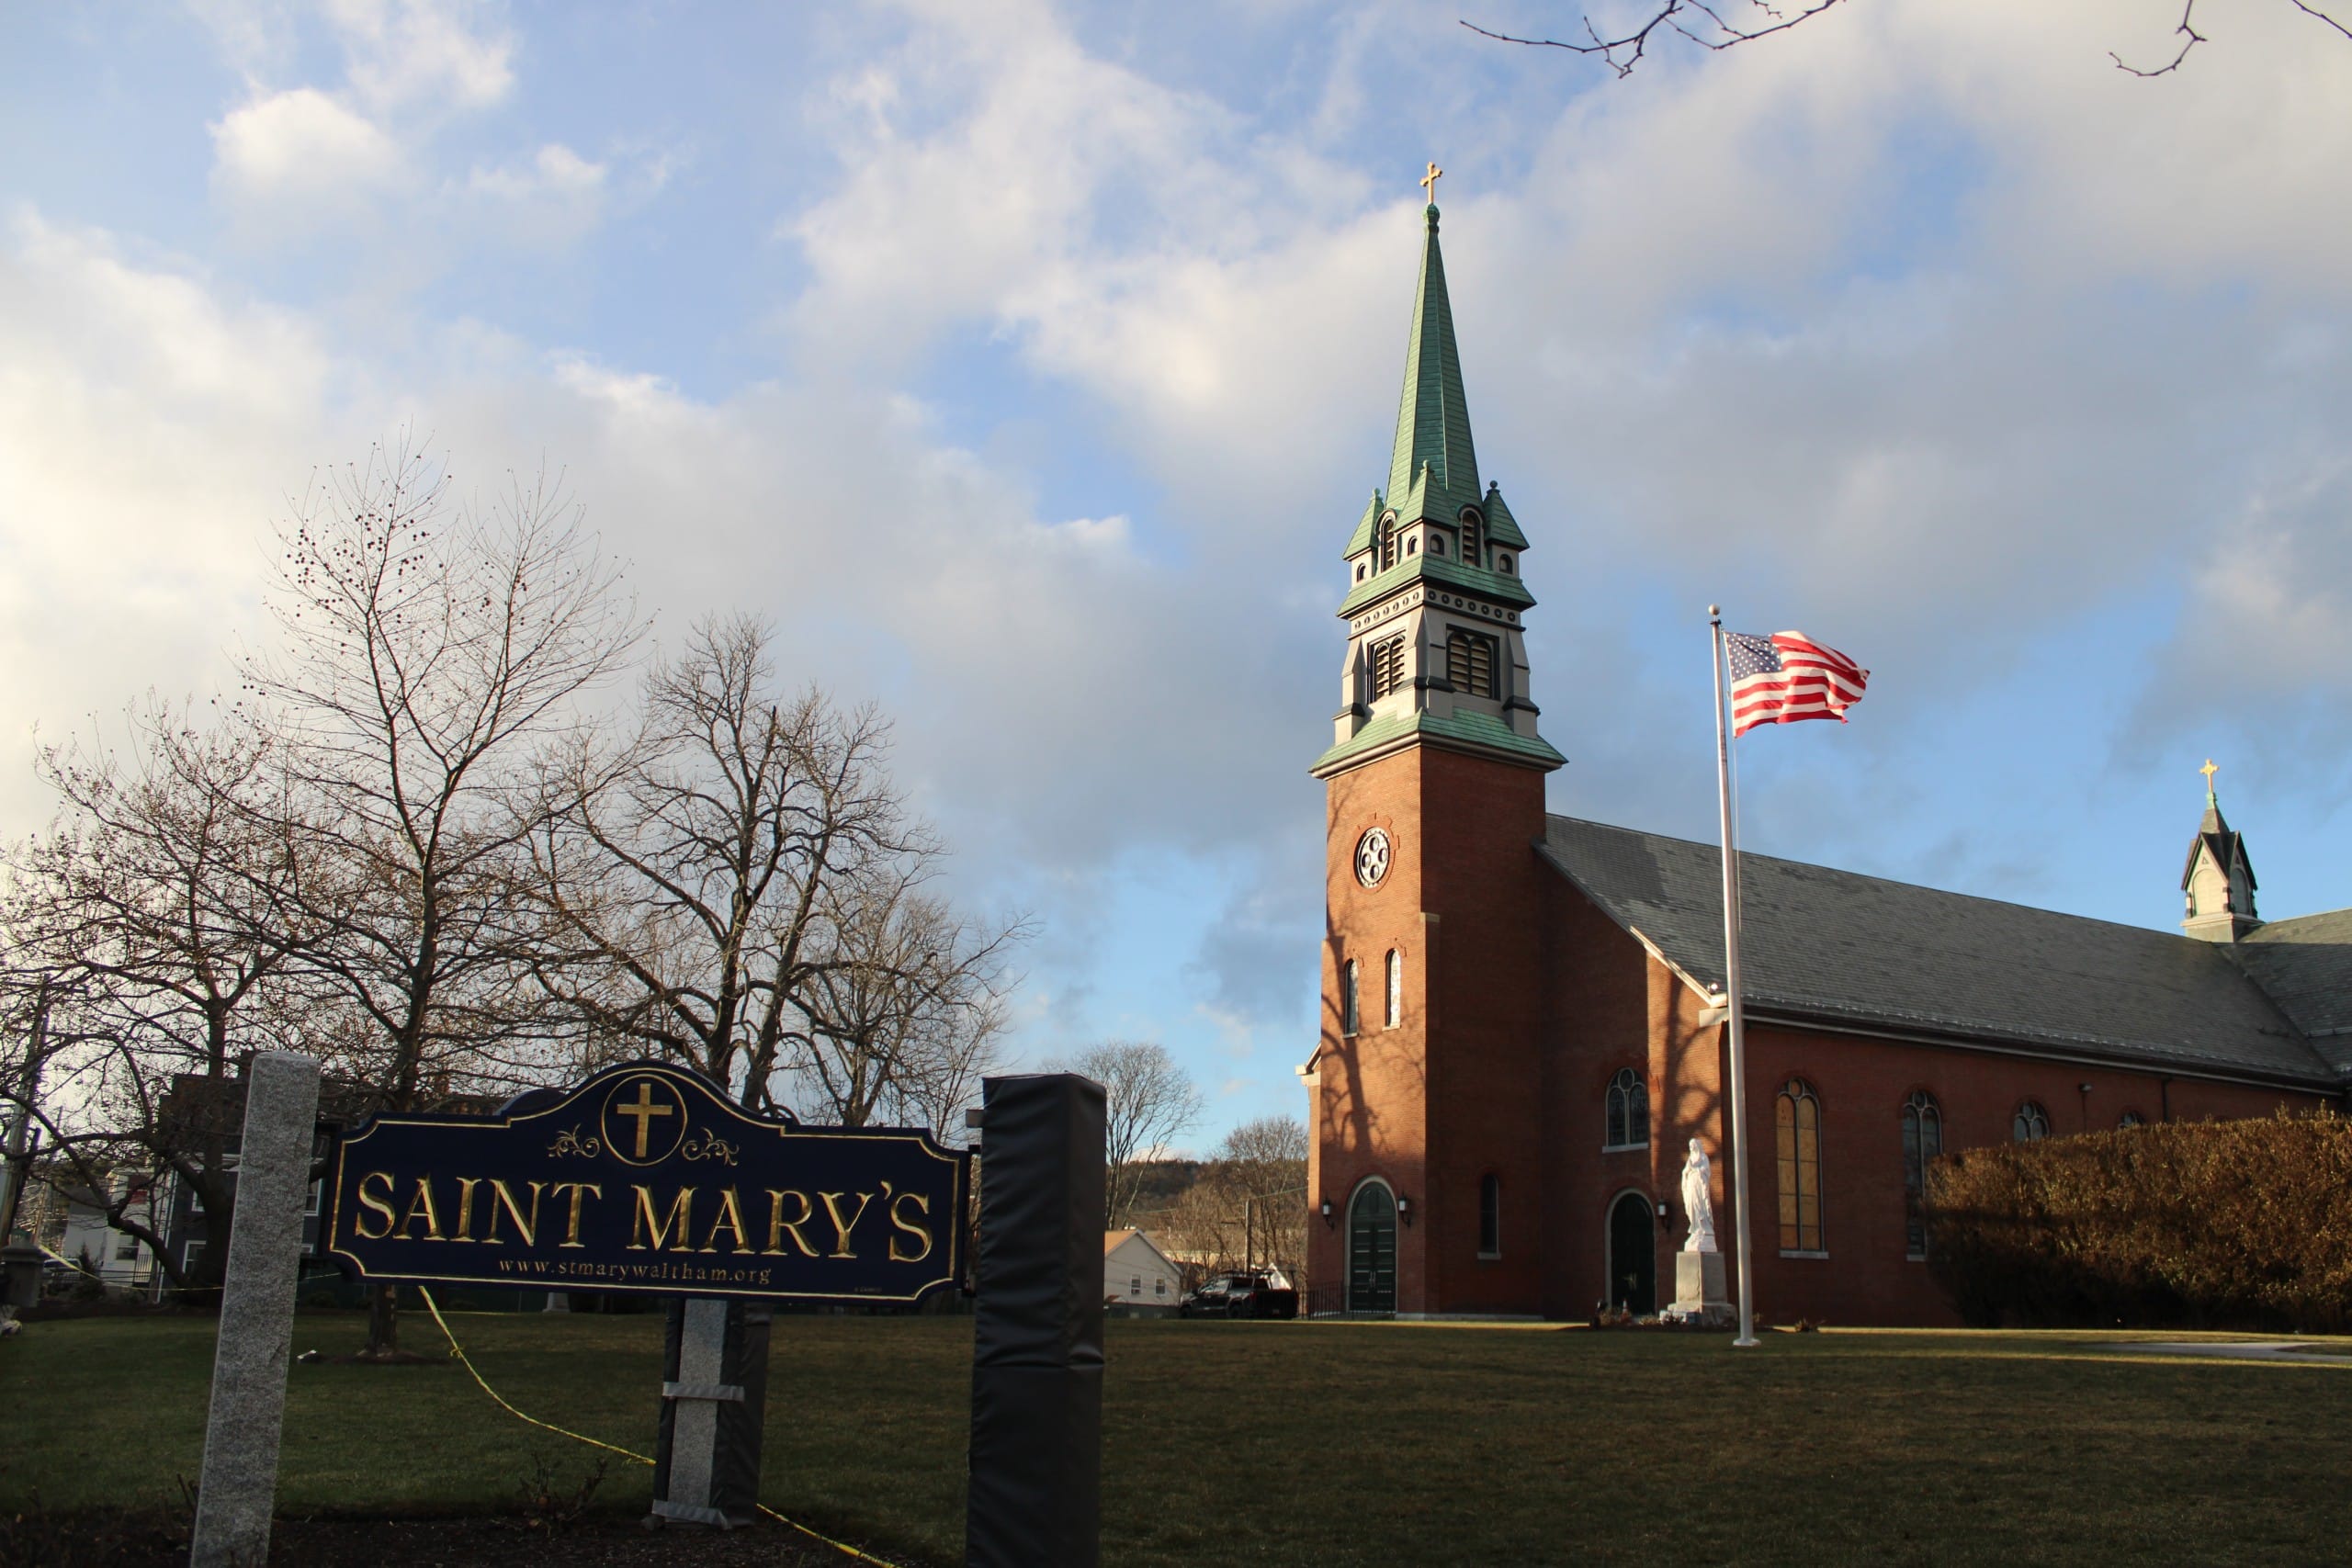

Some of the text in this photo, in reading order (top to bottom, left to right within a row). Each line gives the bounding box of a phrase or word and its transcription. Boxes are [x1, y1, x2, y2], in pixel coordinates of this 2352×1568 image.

[355, 1172, 931, 1261] SAINT MARY'S
[499, 1258, 772, 1285] www.stmarywaltham.org
